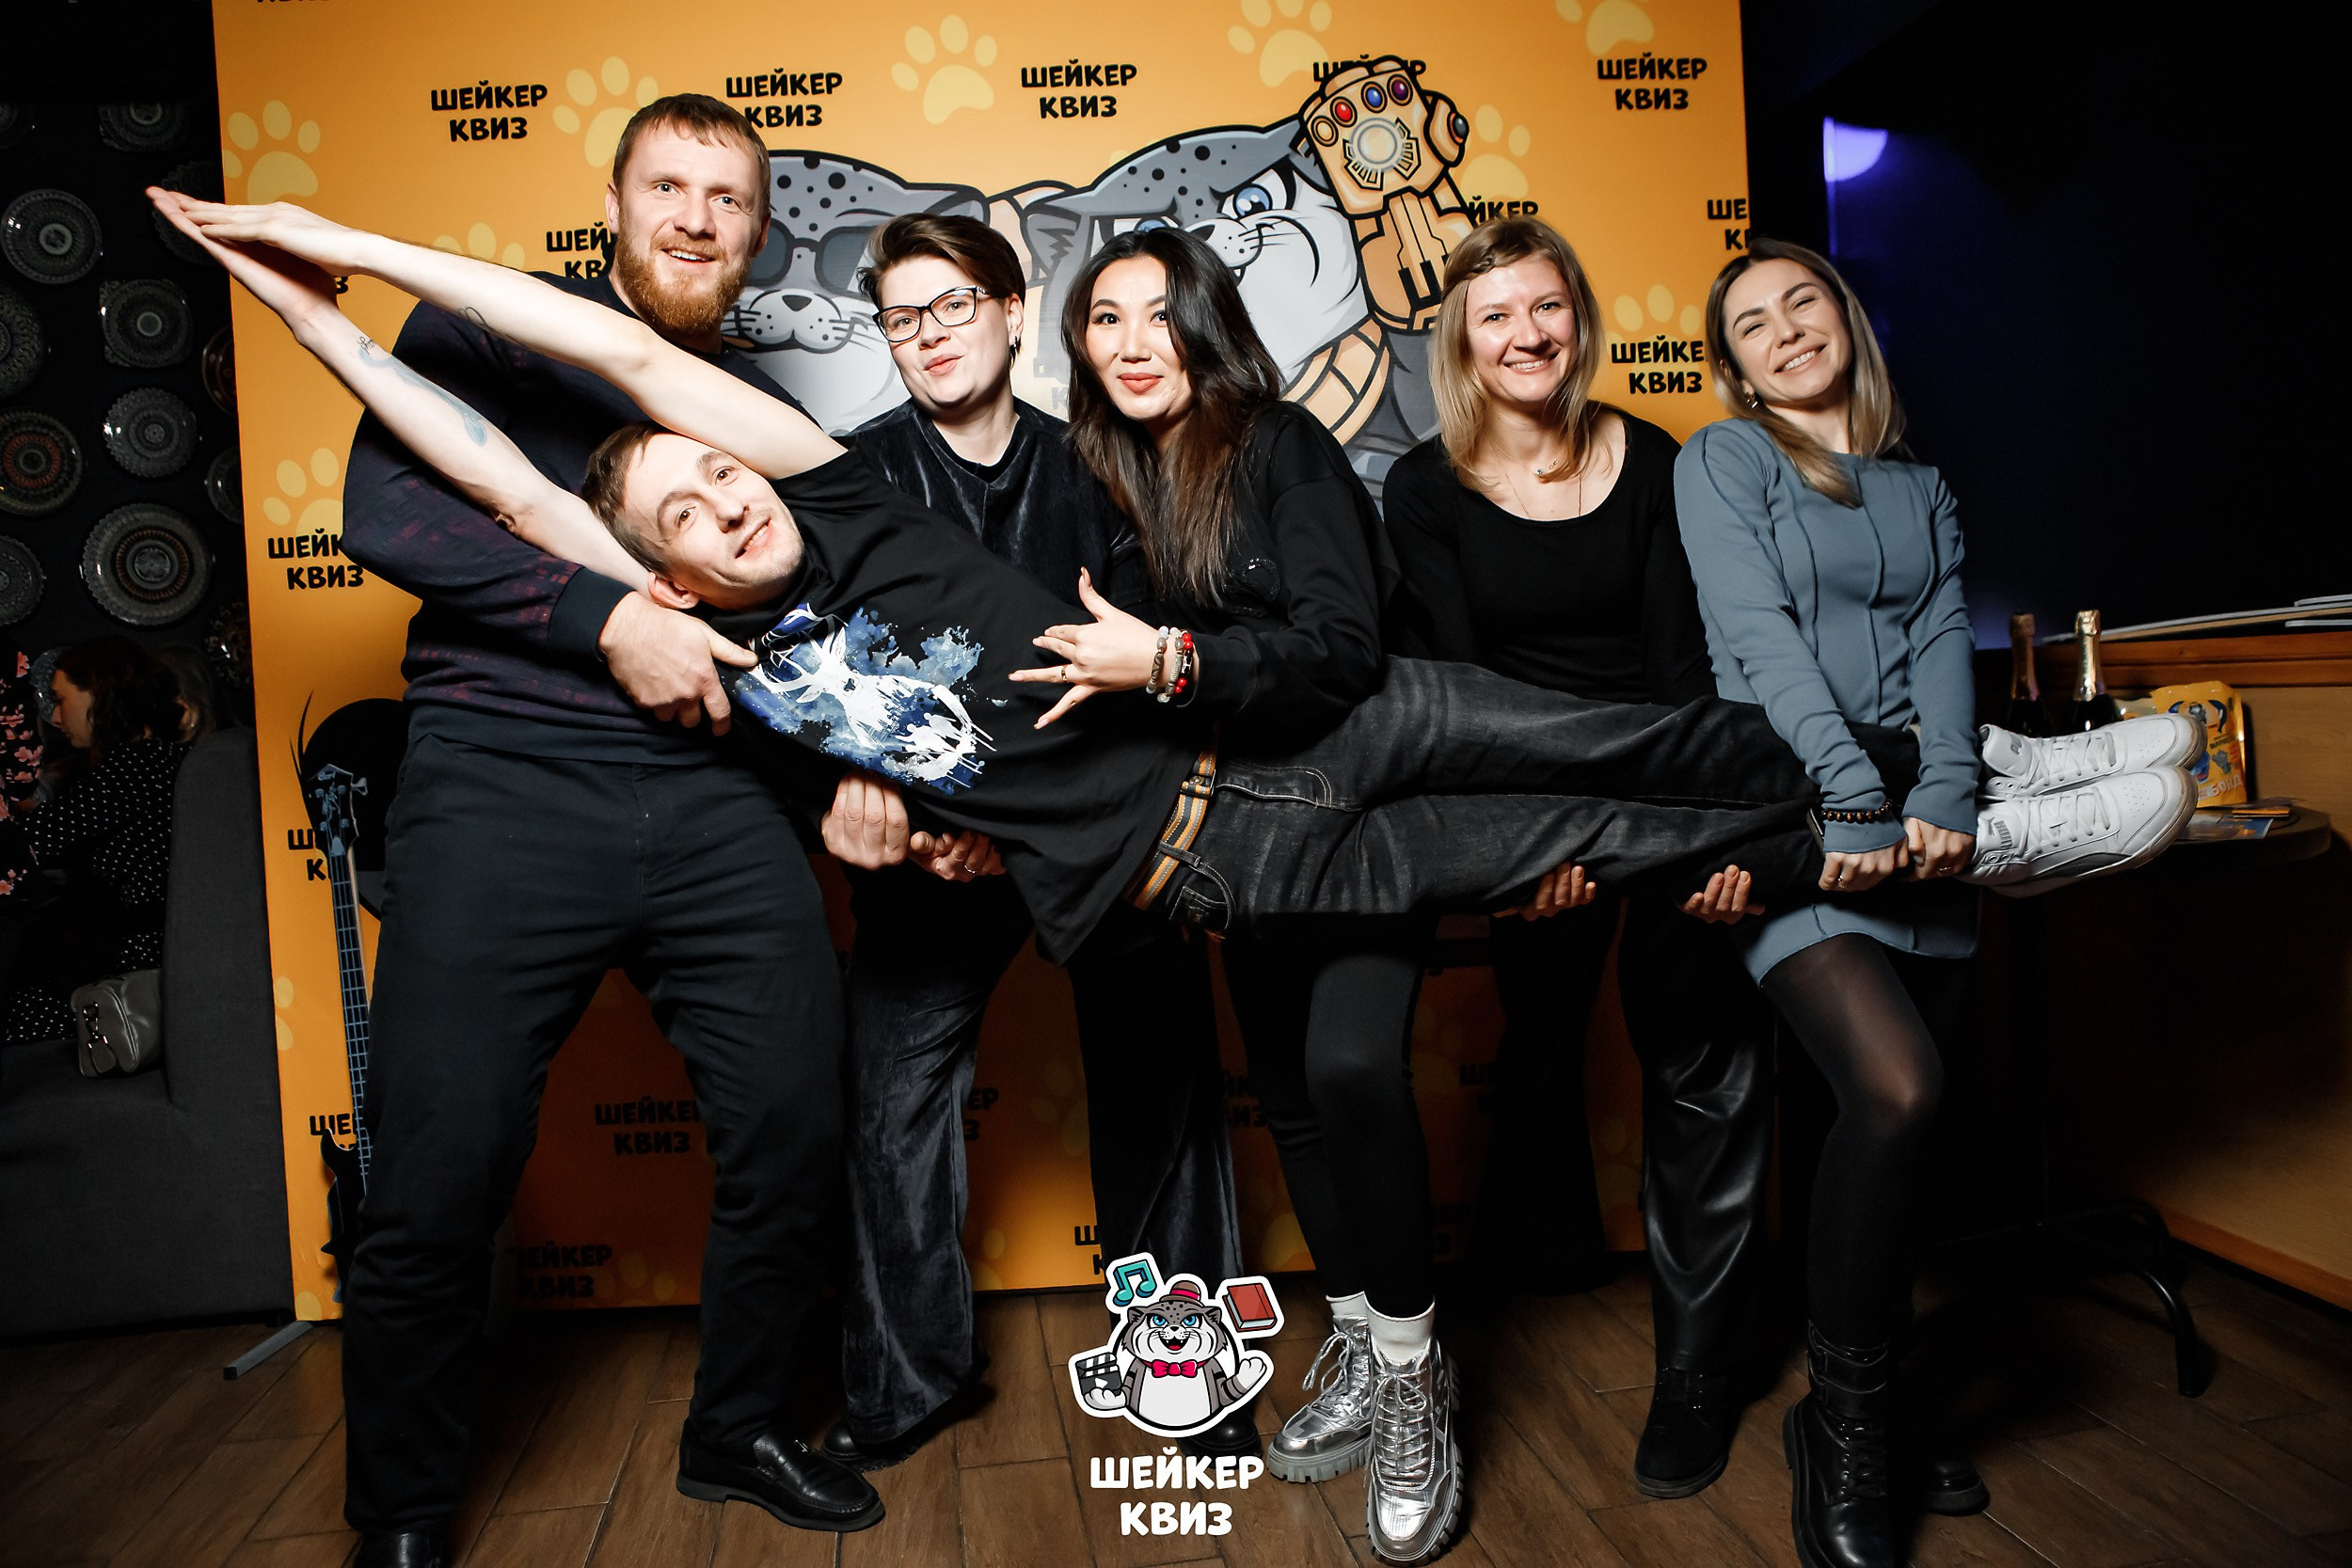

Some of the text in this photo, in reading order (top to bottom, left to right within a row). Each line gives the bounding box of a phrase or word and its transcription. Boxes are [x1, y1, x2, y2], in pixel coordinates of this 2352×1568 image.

[1021, 58, 1137, 87] ШЕЙКЕР
[1597, 52, 1708, 80] ШЕЙКЕР
[431, 80, 548, 111] ШЕЙКЕР
[725, 68, 843, 98] ШЕЙКЕР
[1040, 95, 1117, 119] КВИЗ
[1615, 87, 1689, 110] КВИЗ
[744, 104, 822, 128] КВИЗ
[450, 117, 528, 142] КВИЗ
[1469, 195, 1538, 223] ЙКЕР
[546, 221, 610, 252] ШЕЙ
[1611, 335, 1705, 364] ШЕЙКЕ
[1629, 372, 1703, 394] КВИЗ
[287, 565, 364, 590] КВИЗ
[614, 1132, 690, 1155] КВИЗ
